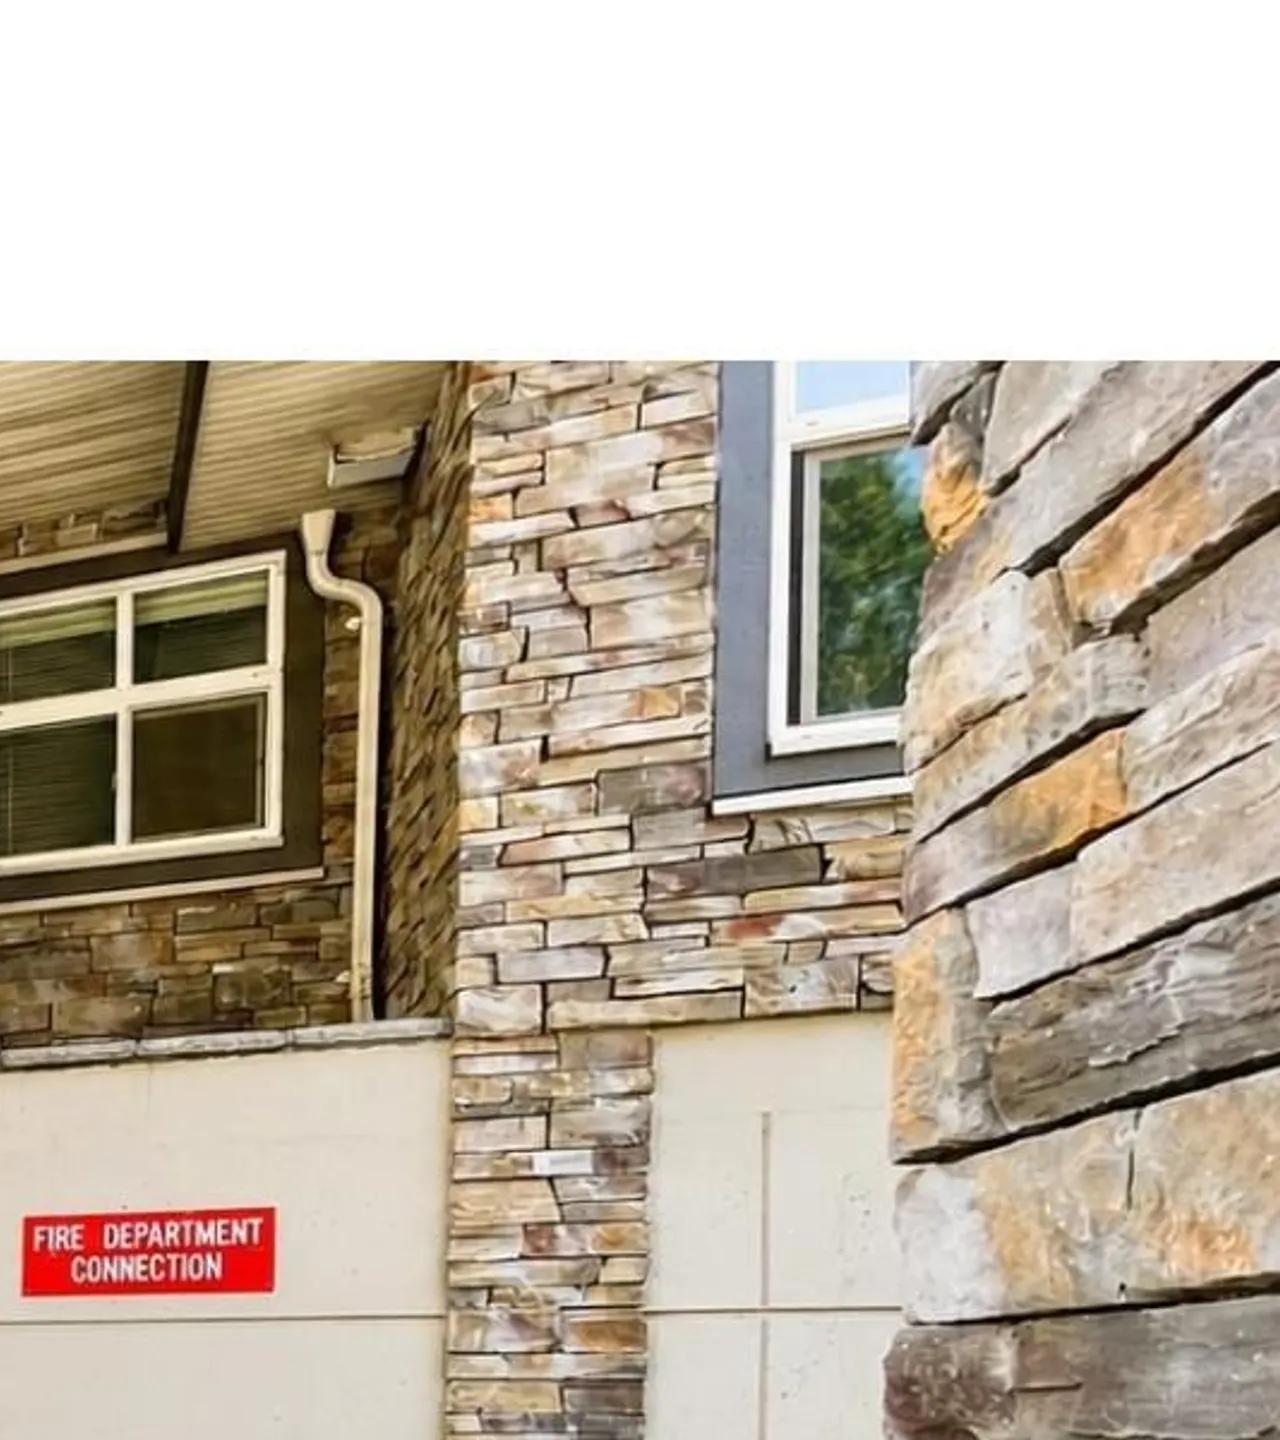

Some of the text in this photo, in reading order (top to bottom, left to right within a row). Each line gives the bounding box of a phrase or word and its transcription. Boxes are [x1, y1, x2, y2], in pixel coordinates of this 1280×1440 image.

[33, 1218, 264, 1252] FIRE DEPARTMENT
[71, 1252, 223, 1283] CONNECTION
